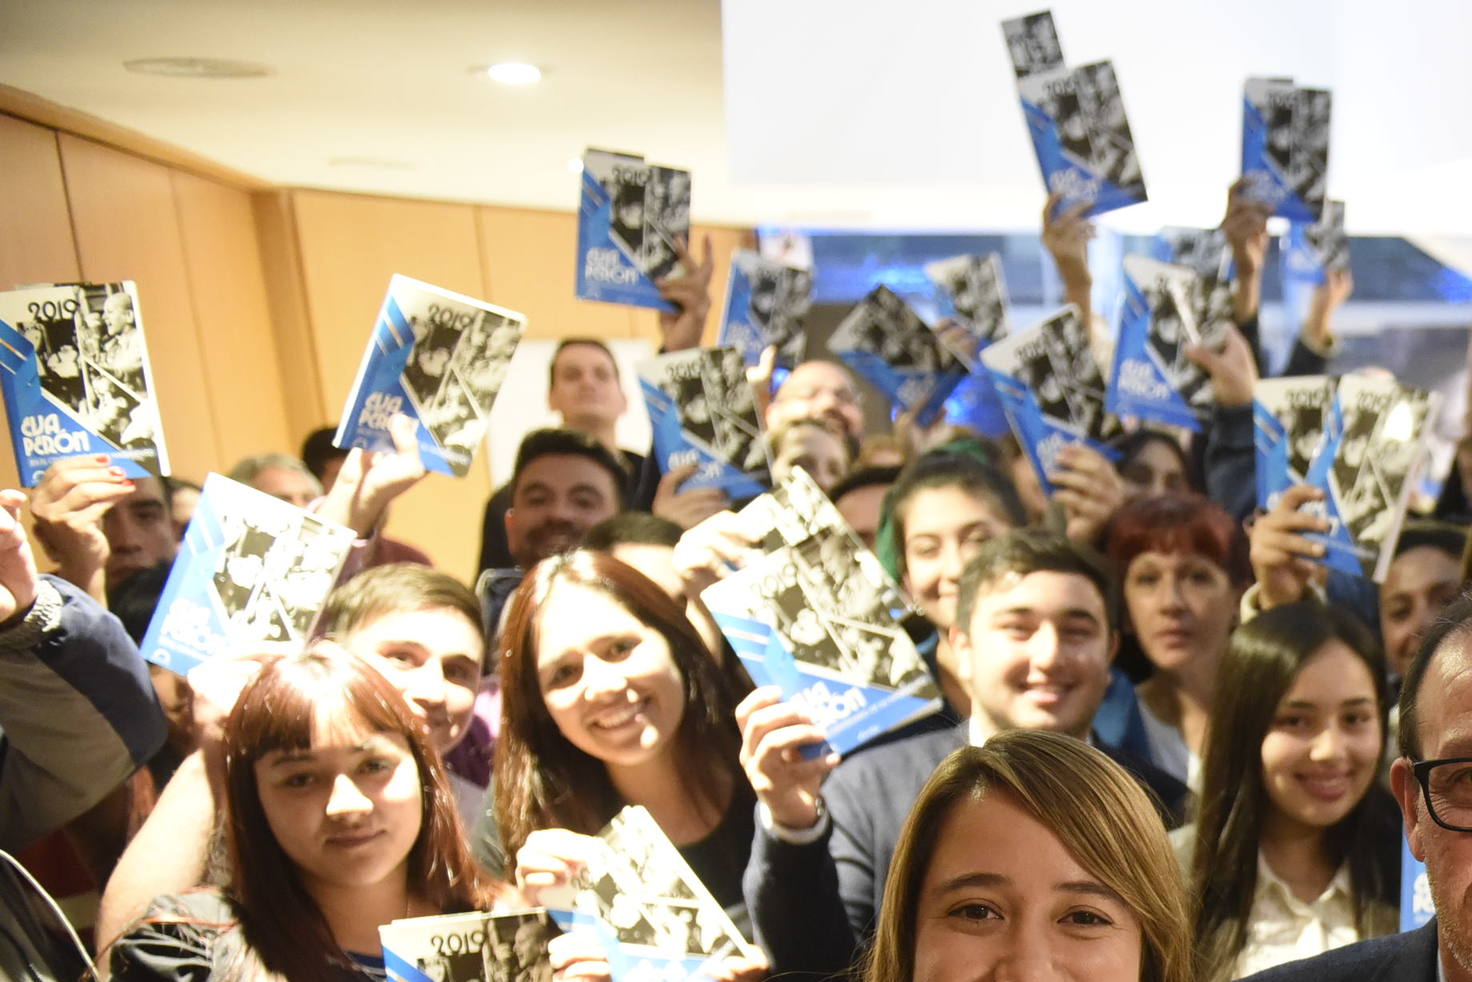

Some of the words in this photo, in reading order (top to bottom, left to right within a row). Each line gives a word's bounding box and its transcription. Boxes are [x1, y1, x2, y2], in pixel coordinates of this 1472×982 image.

[28, 299, 80, 322] 2019
[21, 412, 61, 437] EVA
[22, 427, 90, 458] PERÓN
[430, 930, 486, 957] 2019
